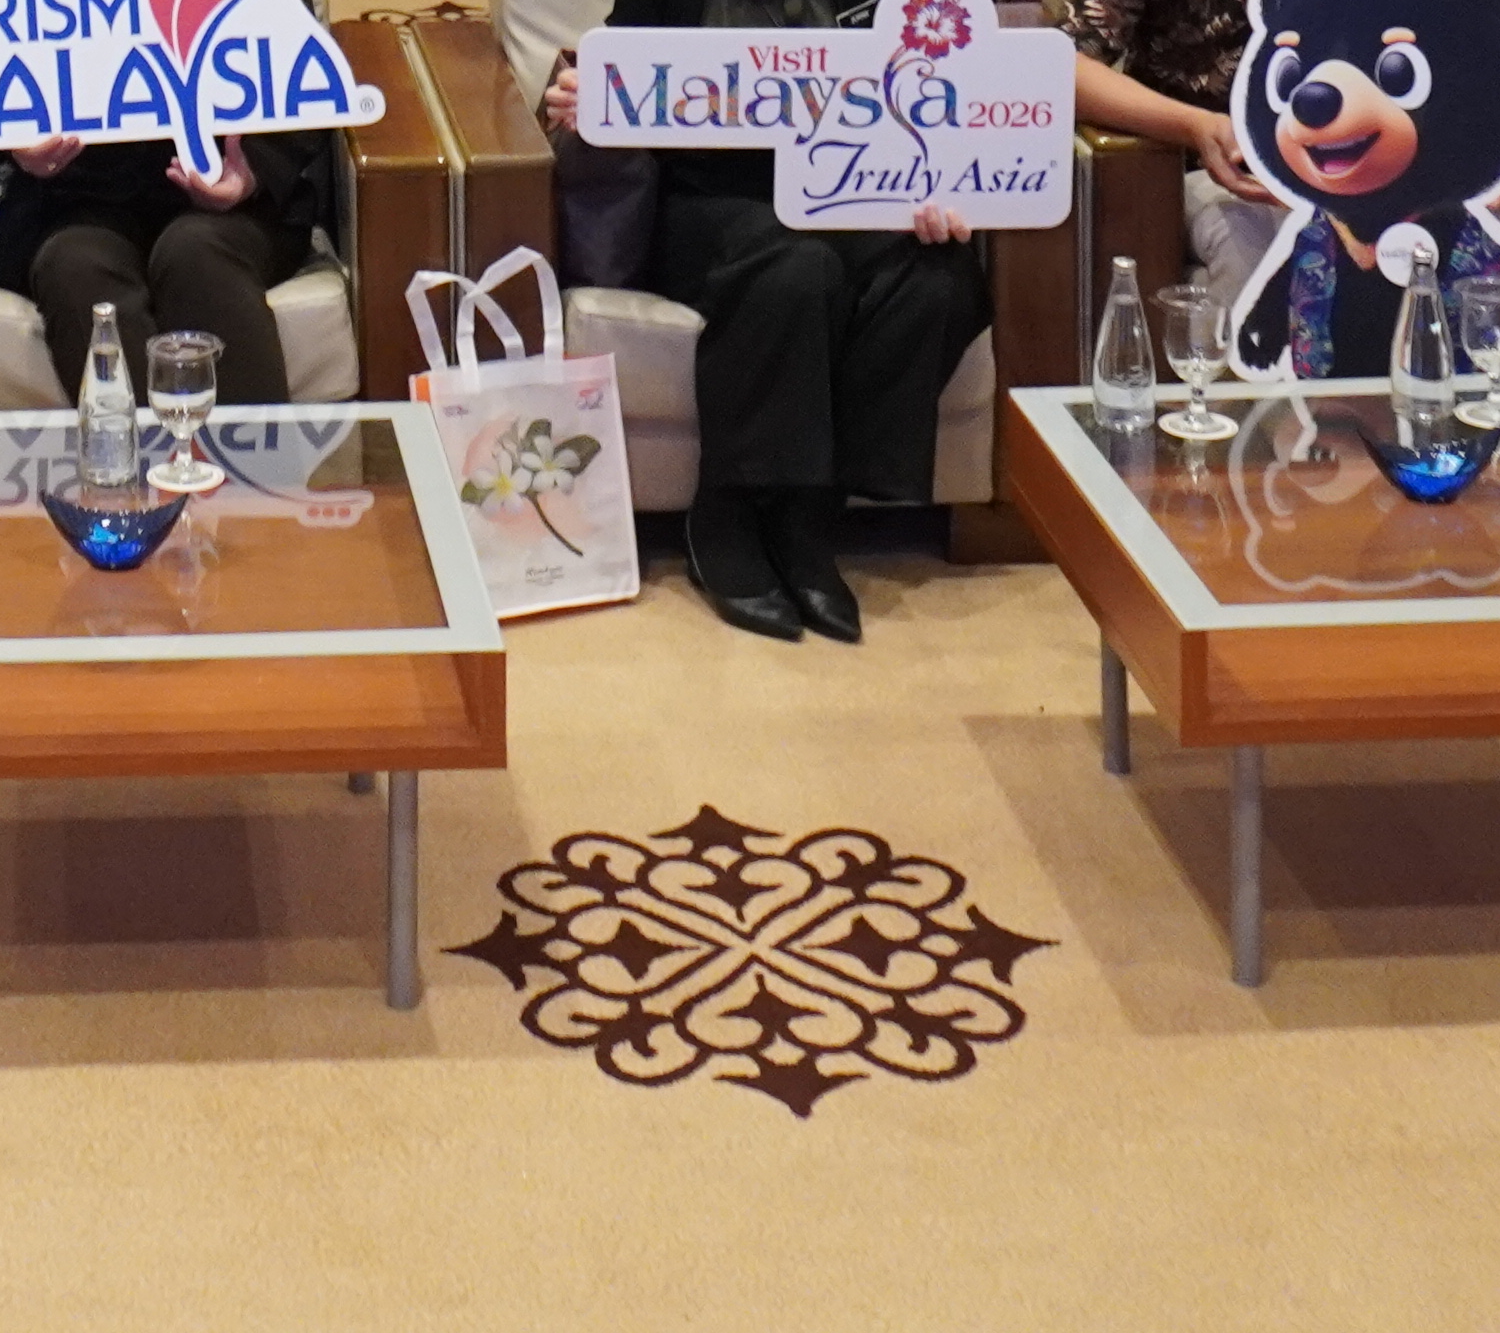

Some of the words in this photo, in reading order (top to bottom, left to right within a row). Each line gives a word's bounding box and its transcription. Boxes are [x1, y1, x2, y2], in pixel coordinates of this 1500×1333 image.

[600, 47, 961, 145] Malaysia
[966, 100, 1053, 129] 2026
[748, 45, 829, 73] Visit
[803, 141, 942, 215] Truly
[950, 157, 1047, 193] Asia
